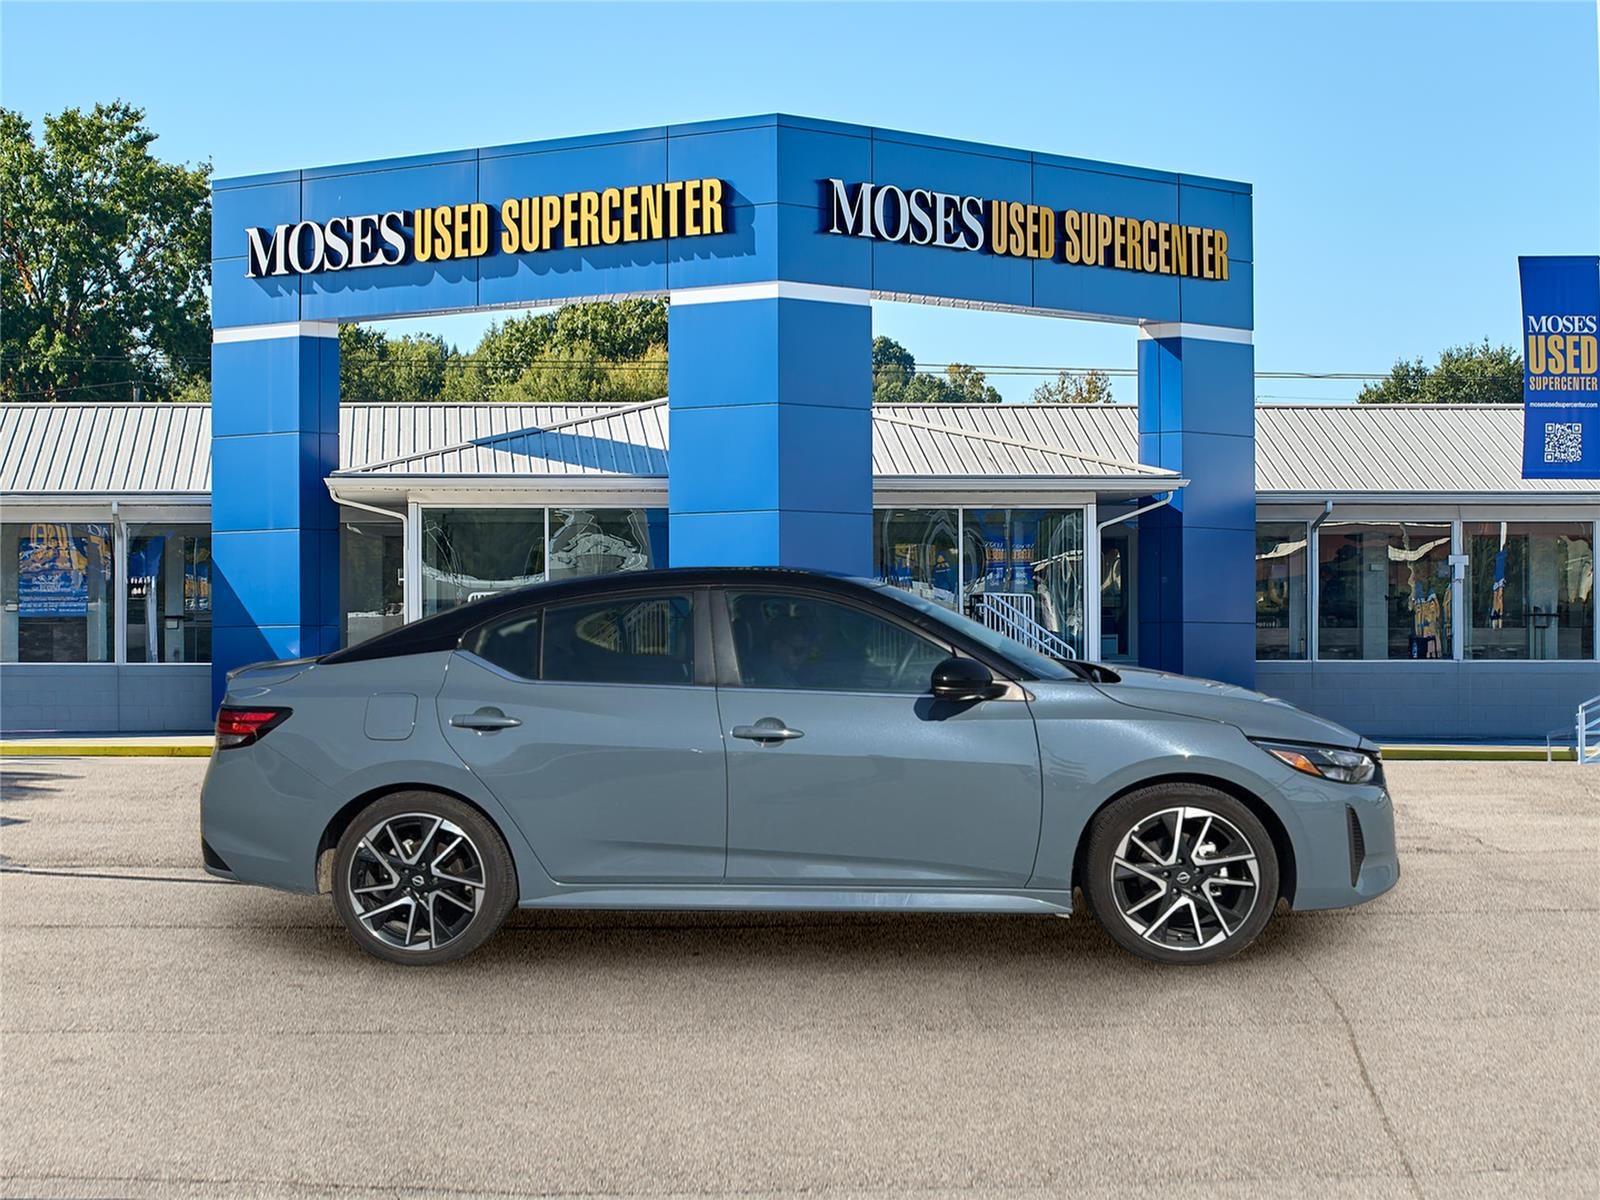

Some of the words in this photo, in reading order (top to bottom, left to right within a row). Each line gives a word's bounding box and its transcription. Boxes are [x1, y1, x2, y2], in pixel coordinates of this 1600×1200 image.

[245, 212, 407, 279] MOSES
[413, 203, 490, 262] USED
[501, 177, 725, 254] SUPERCENTER
[829, 178, 985, 251] MOSES
[991, 200, 1055, 259] USED
[1065, 210, 1229, 281] SUPERCENTER
[1528, 315, 1597, 333] MOSES
[1528, 335, 1598, 374] USED
[1529, 376, 1598, 391] SUPERCENTER
